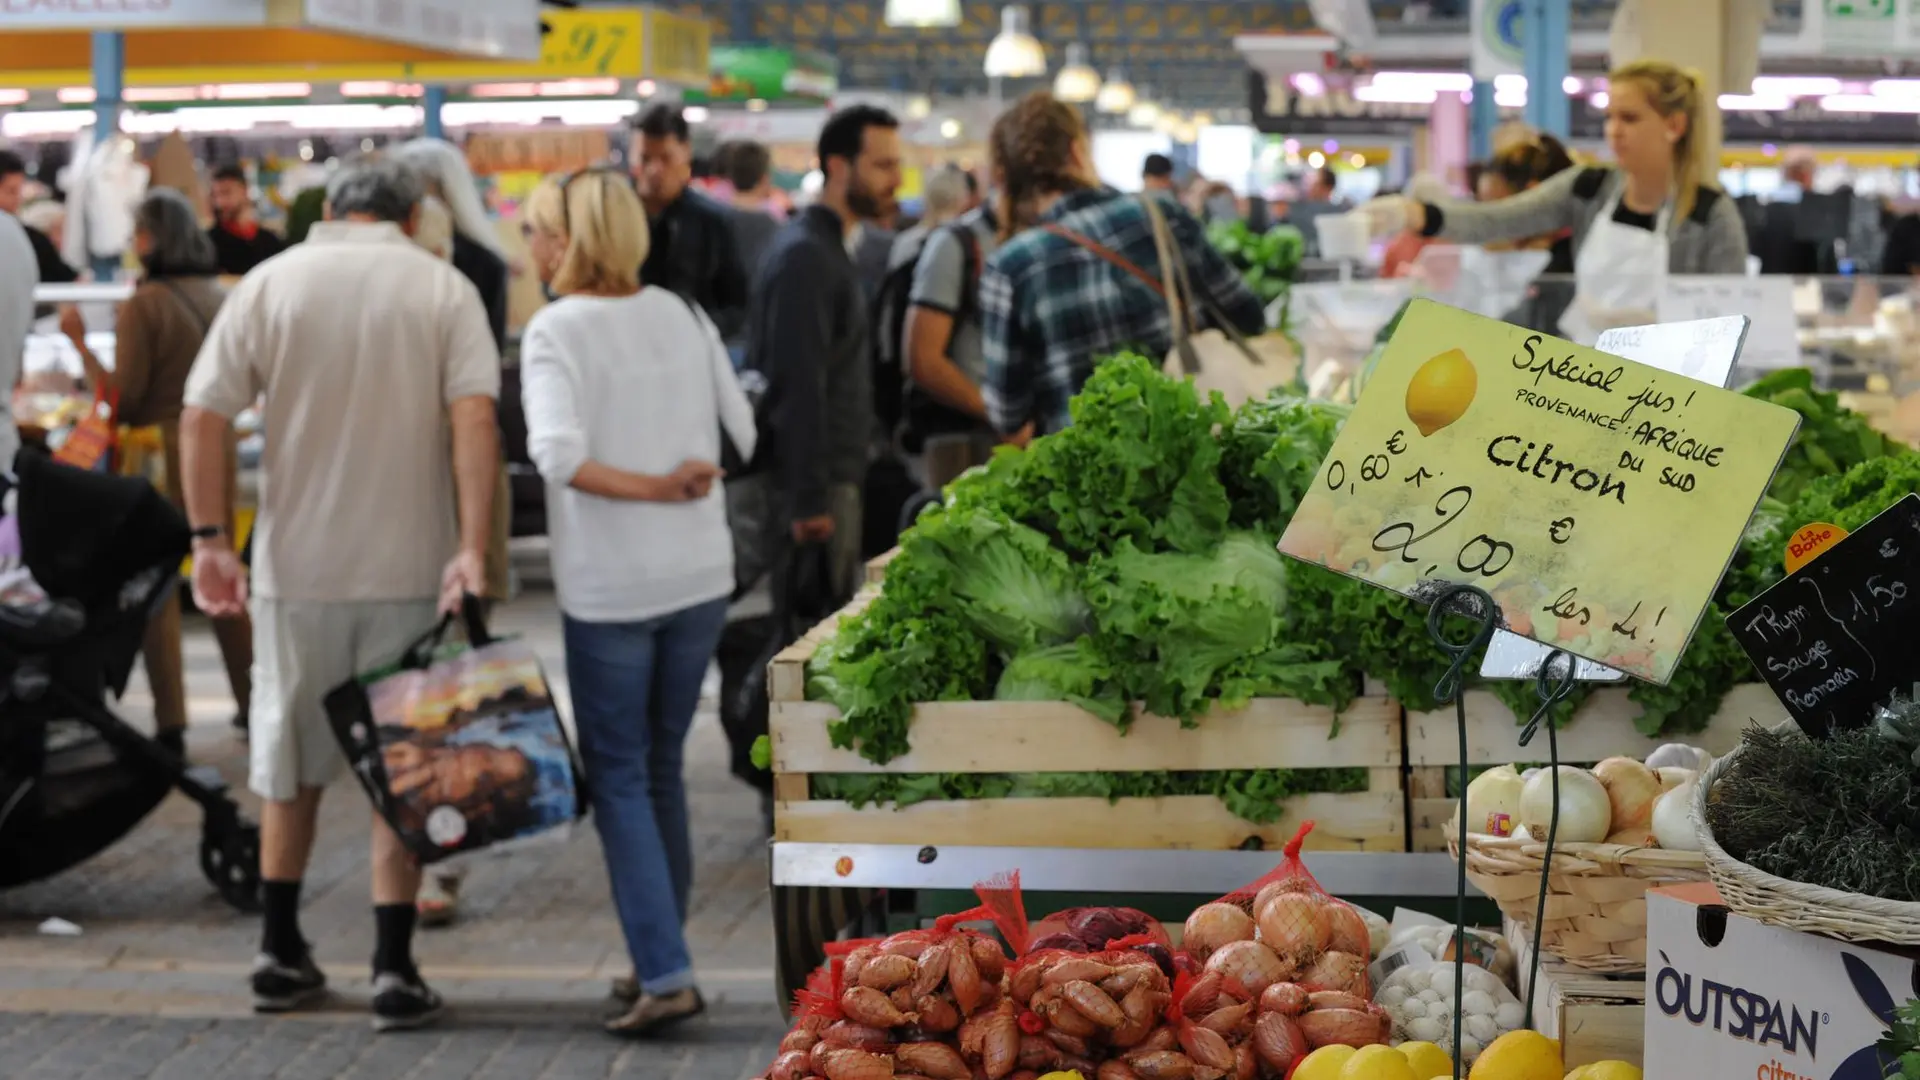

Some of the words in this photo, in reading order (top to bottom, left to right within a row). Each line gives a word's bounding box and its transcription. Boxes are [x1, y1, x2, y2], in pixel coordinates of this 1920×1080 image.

[1512, 335, 1624, 393] Spécial
[1487, 434, 1628, 504] Citron
[1618, 449, 1645, 471] DU
[1659, 465, 1697, 493] SUD
[1372, 485, 1514, 577] 2,00
[1789, 530, 1832, 558] Botte
[1799, 530, 1814, 541] La
[1542, 587, 1591, 625] les
[1745, 604, 1812, 646] Thym
[1766, 639, 1833, 682] Sauge
